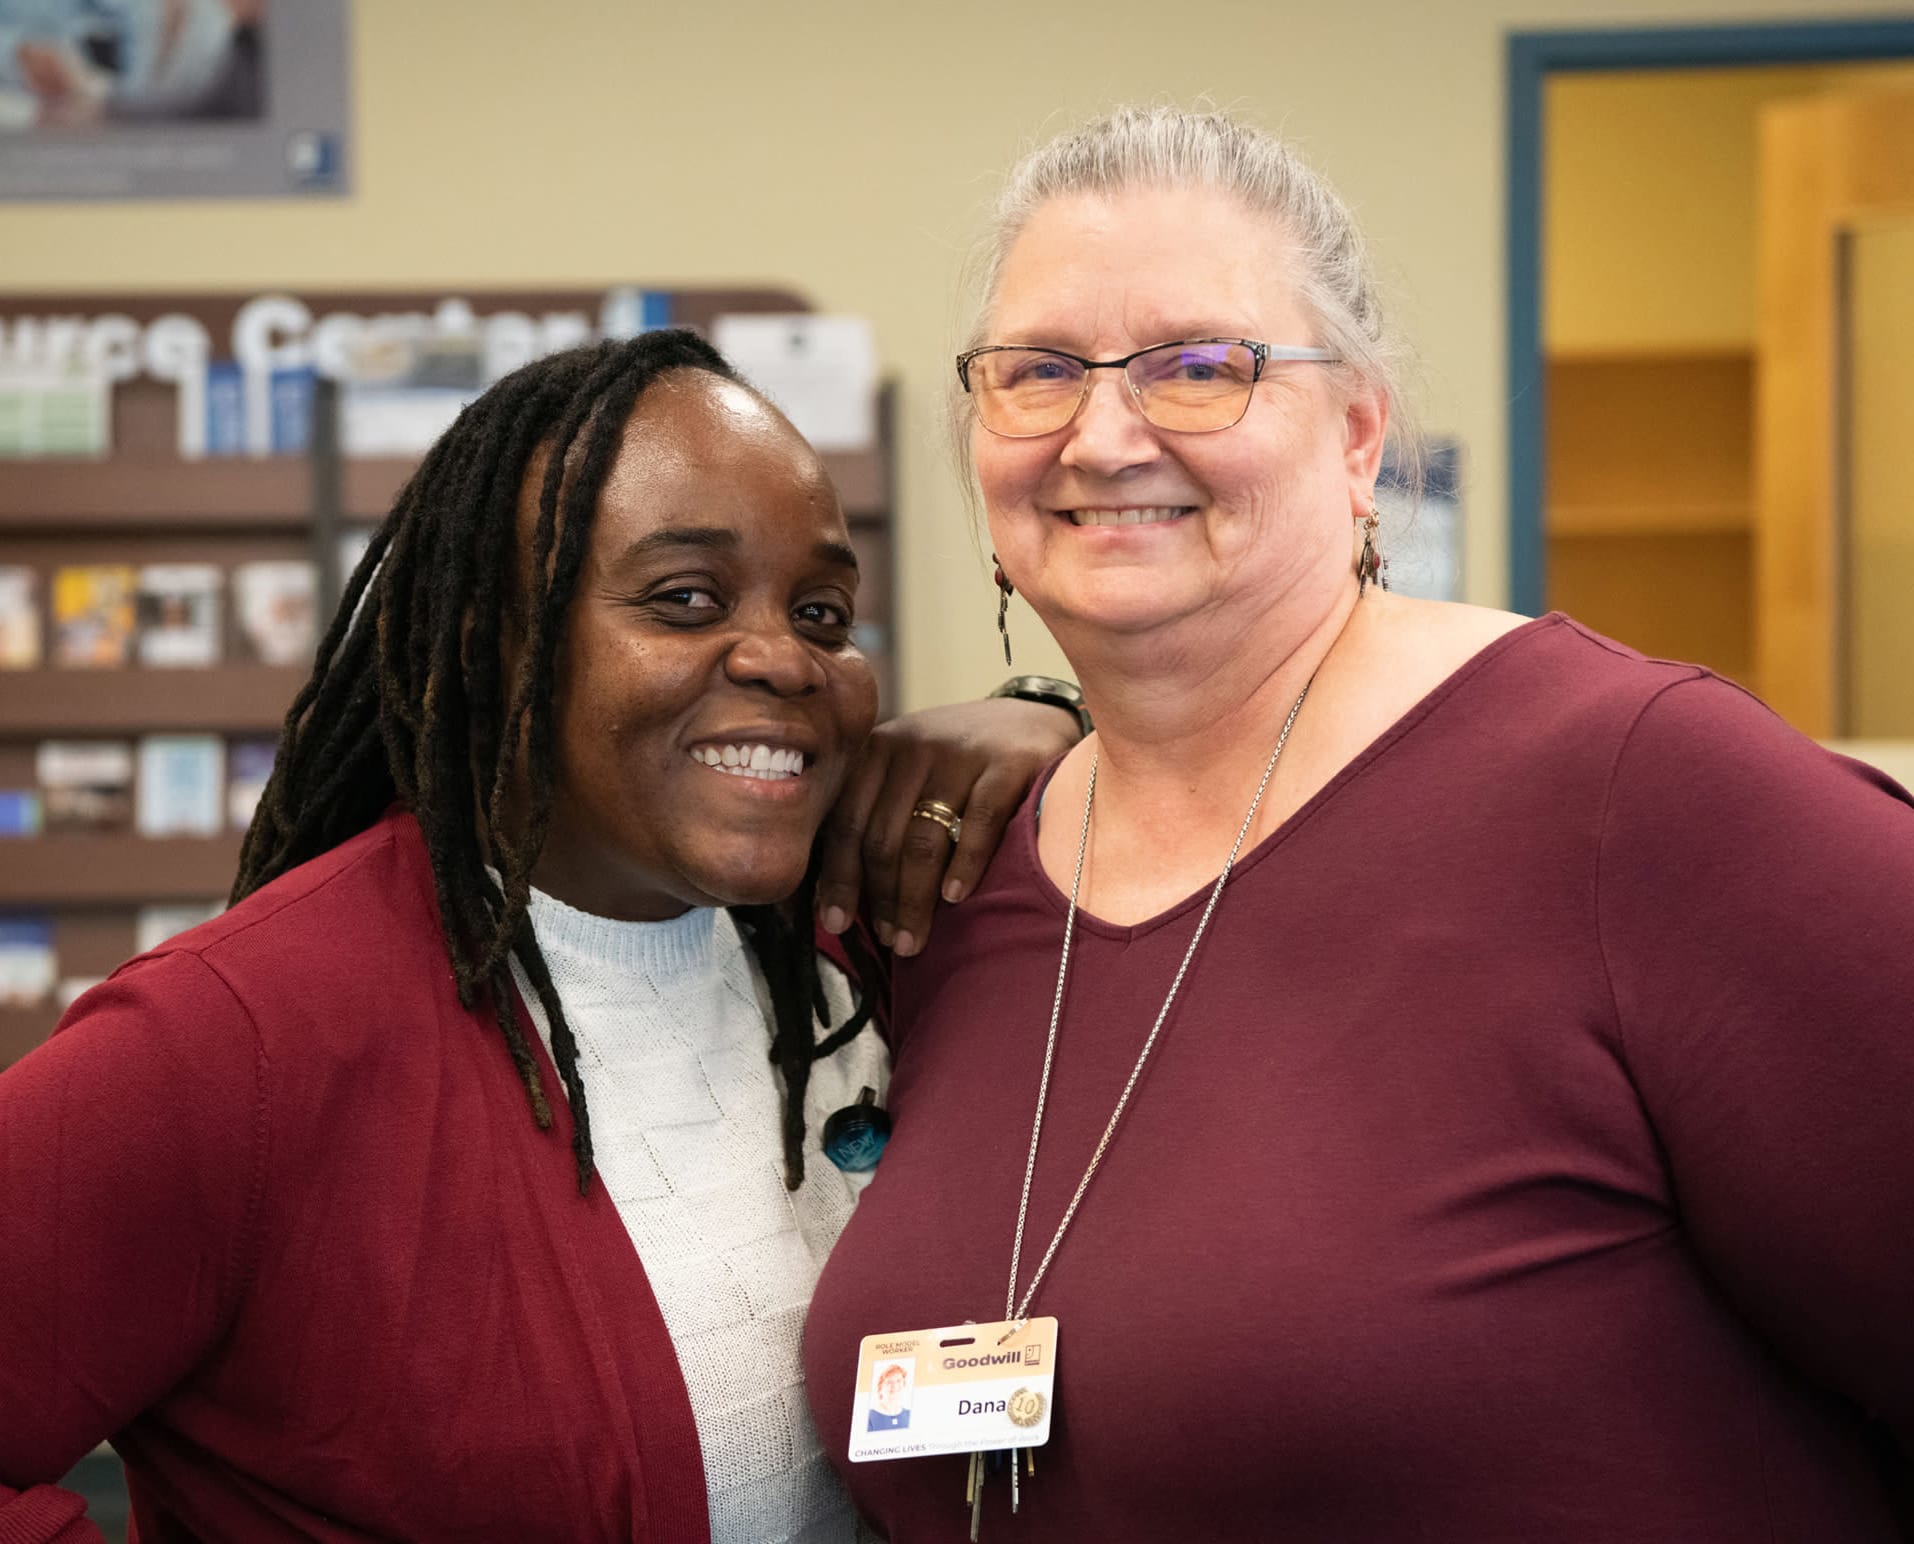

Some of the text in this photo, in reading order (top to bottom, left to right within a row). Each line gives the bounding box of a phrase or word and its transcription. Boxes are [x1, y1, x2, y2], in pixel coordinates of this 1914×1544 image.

[943, 1351, 1020, 1370] Goodwill
[958, 1399, 1006, 1415] Dana
[1015, 1397, 1036, 1415] 10
[854, 1446, 900, 1457] CHANGING
[902, 1444, 927, 1453] LIVES
